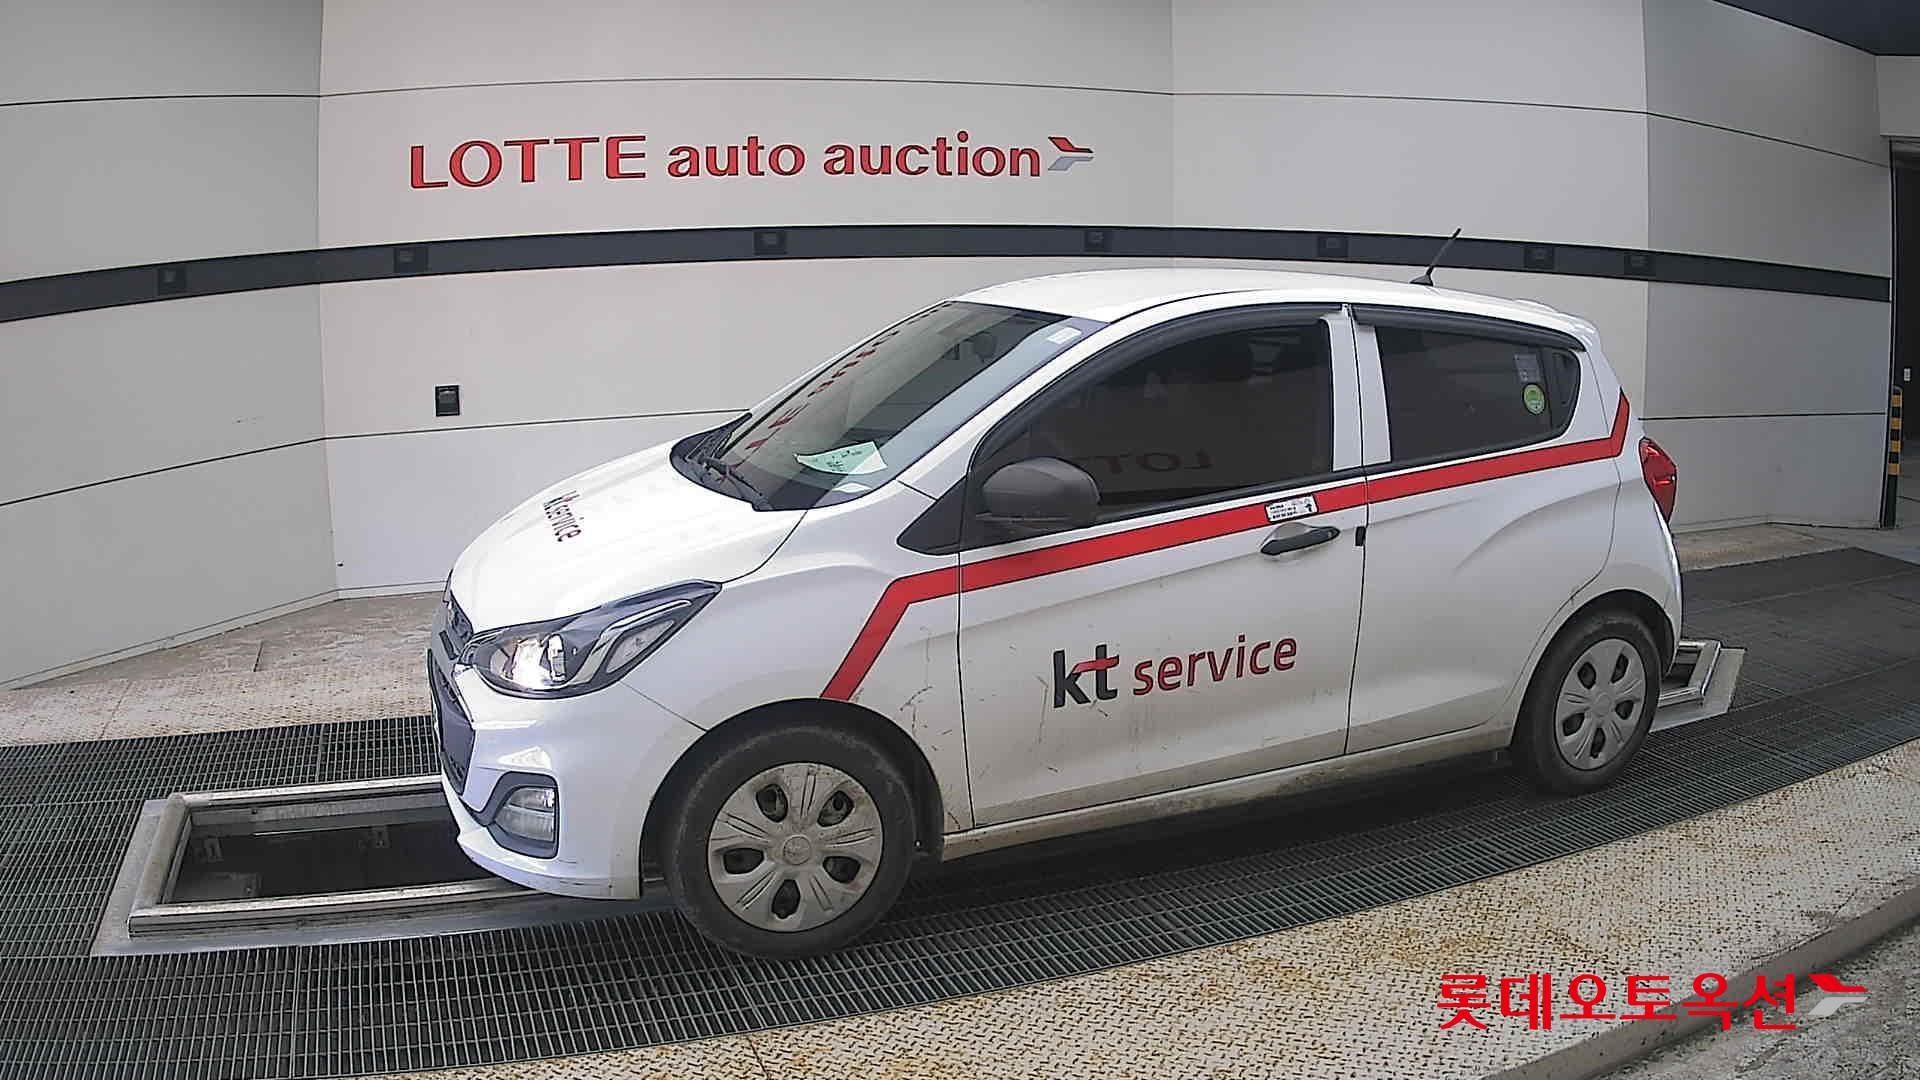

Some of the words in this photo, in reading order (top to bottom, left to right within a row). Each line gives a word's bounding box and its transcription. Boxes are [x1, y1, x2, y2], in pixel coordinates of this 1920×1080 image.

[410, 136, 646, 188] LOTTE
[667, 136, 806, 177] auto
[823, 131, 1041, 177] auction
[546, 503, 585, 542] service
[1052, 644, 1120, 708] kt
[1132, 634, 1297, 696] service
